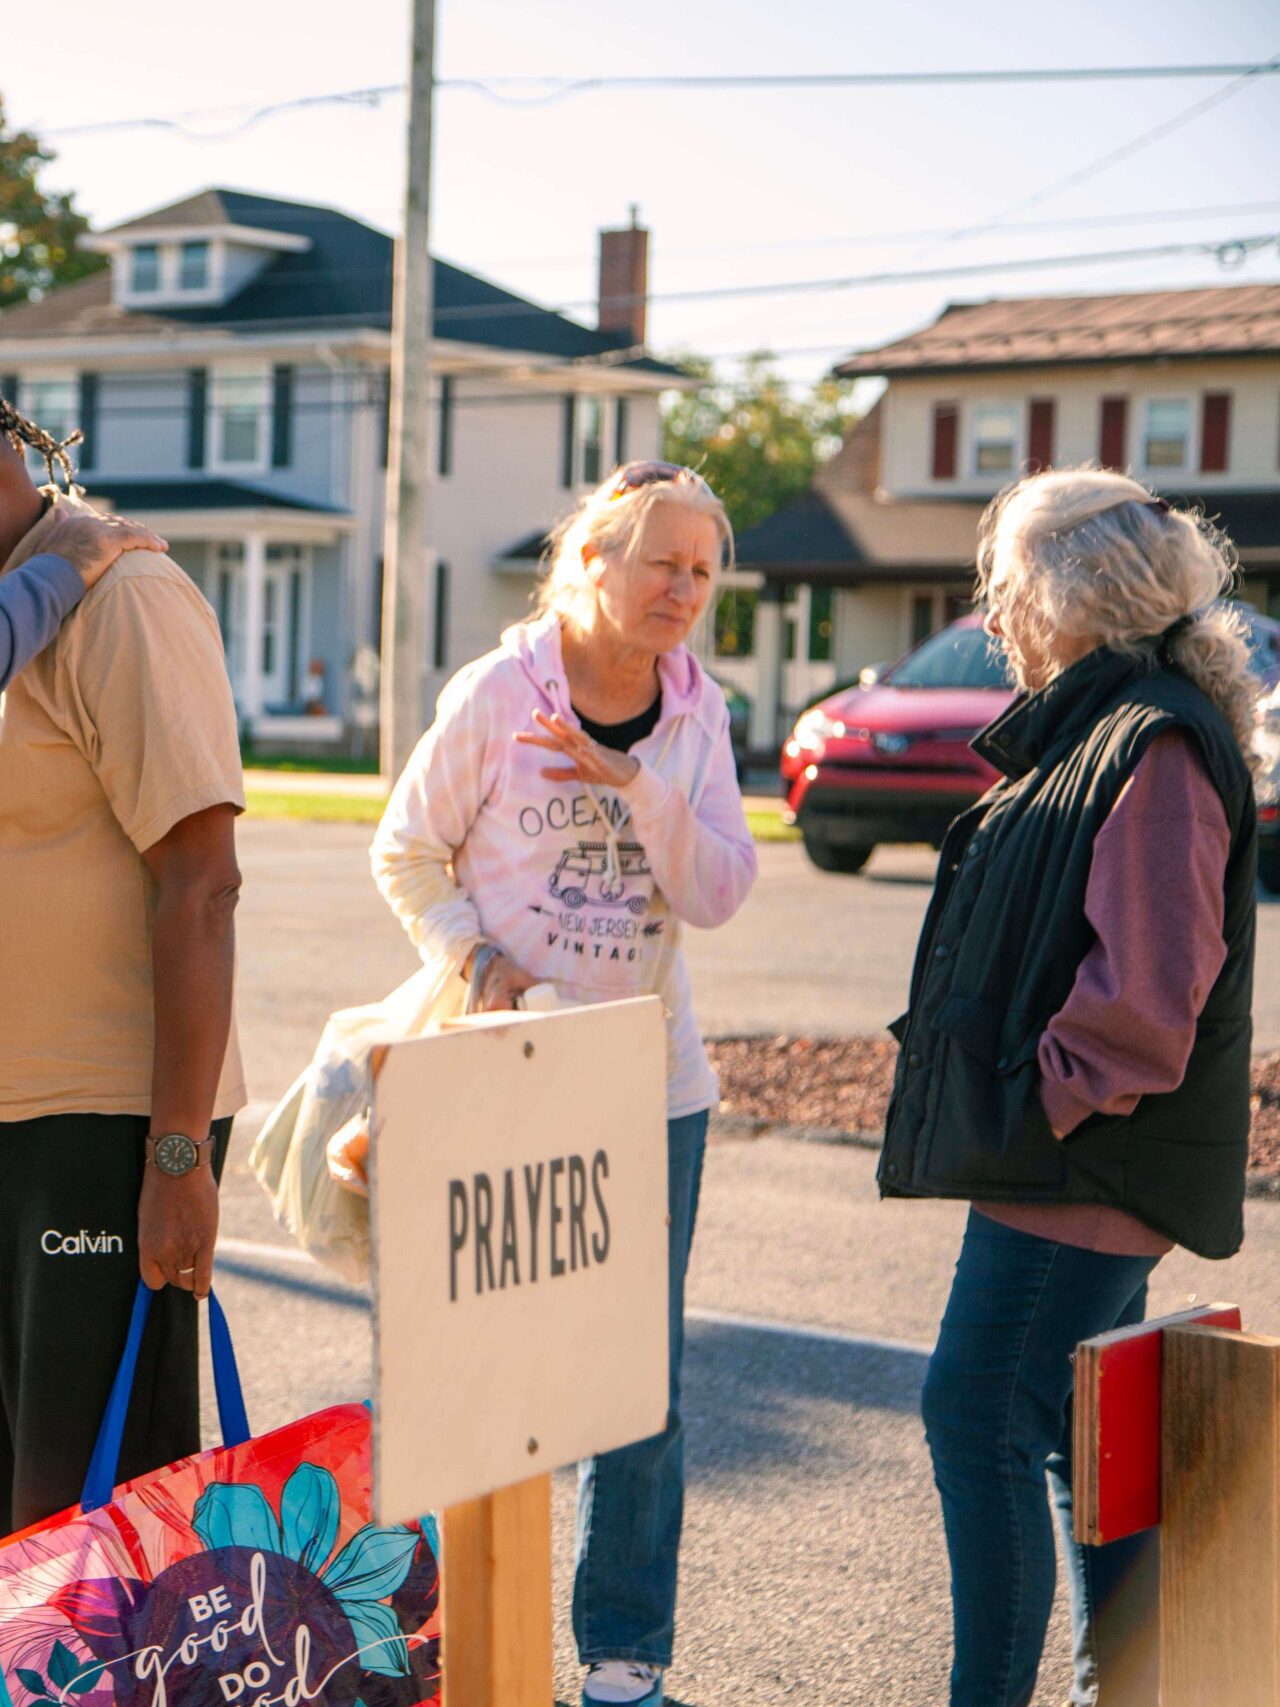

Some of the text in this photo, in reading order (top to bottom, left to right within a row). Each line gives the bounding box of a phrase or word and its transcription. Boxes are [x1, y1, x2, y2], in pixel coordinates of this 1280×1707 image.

[558, 912, 640, 939] NEW JERSEY
[547, 932, 643, 962] VINTAG
[40, 1229, 123, 1254] Calvin
[448, 1149, 611, 1303] PRAYERS
[187, 1585, 232, 1623] BE
[59, 1552, 285, 1707] good
[218, 1661, 270, 1702] DO
